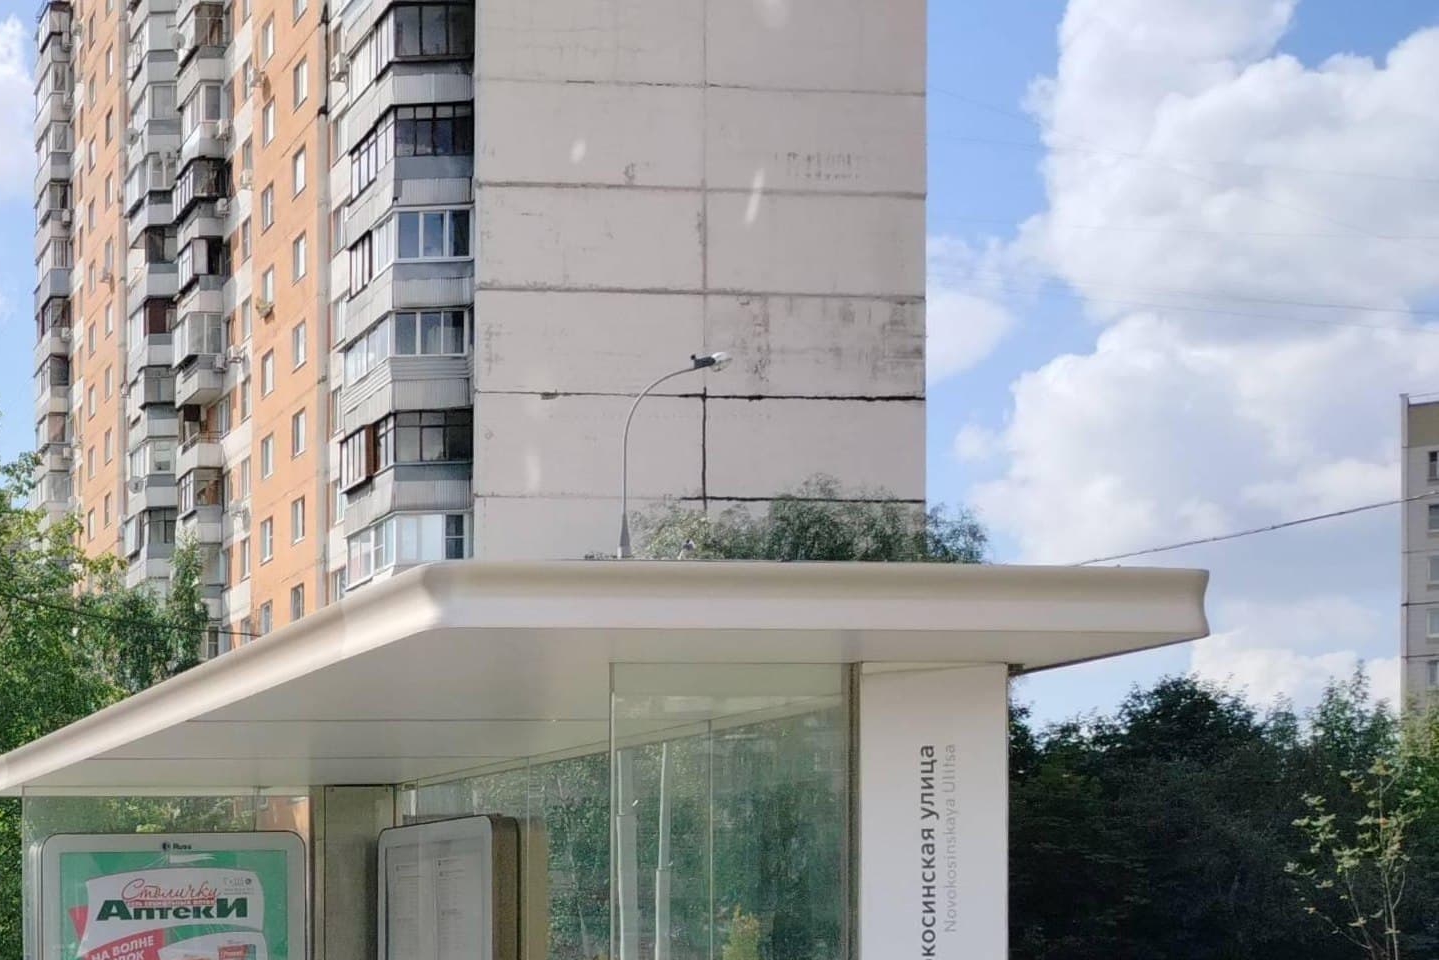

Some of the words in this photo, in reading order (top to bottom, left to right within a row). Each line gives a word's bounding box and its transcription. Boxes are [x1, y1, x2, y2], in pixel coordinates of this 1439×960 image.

[920, 744, 940, 820] улица
[942, 743, 957, 793] Ulitsa
[943, 799, 959, 933] Novokosinskaya
[112, 935, 155, 957] ВОЛНЕ
